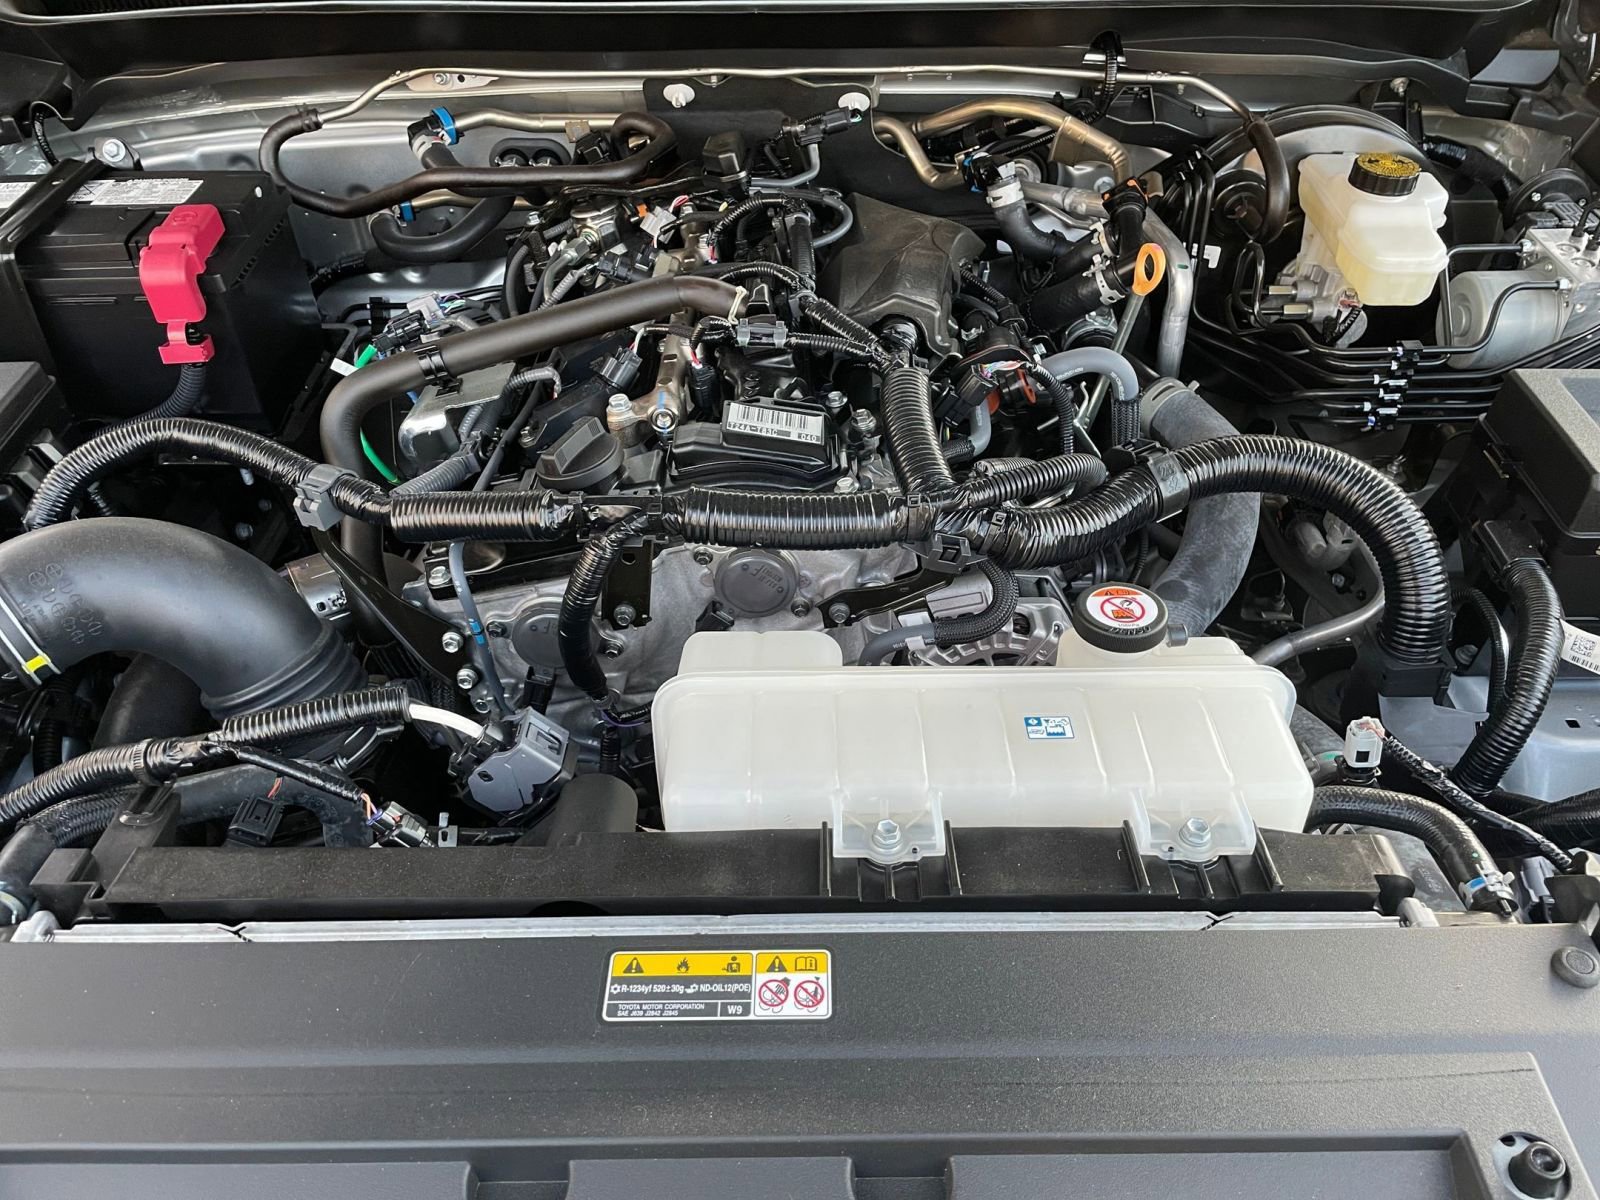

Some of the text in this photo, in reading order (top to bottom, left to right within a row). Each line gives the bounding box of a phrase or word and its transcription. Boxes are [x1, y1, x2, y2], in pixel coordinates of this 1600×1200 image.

[621, 983, 684, 994] R-1234yf 520±30g
[699, 983, 752, 993] ND-OIL12(POE)
[618, 1003, 641, 1011] TOYOTA
[727, 1005, 743, 1015] W9
